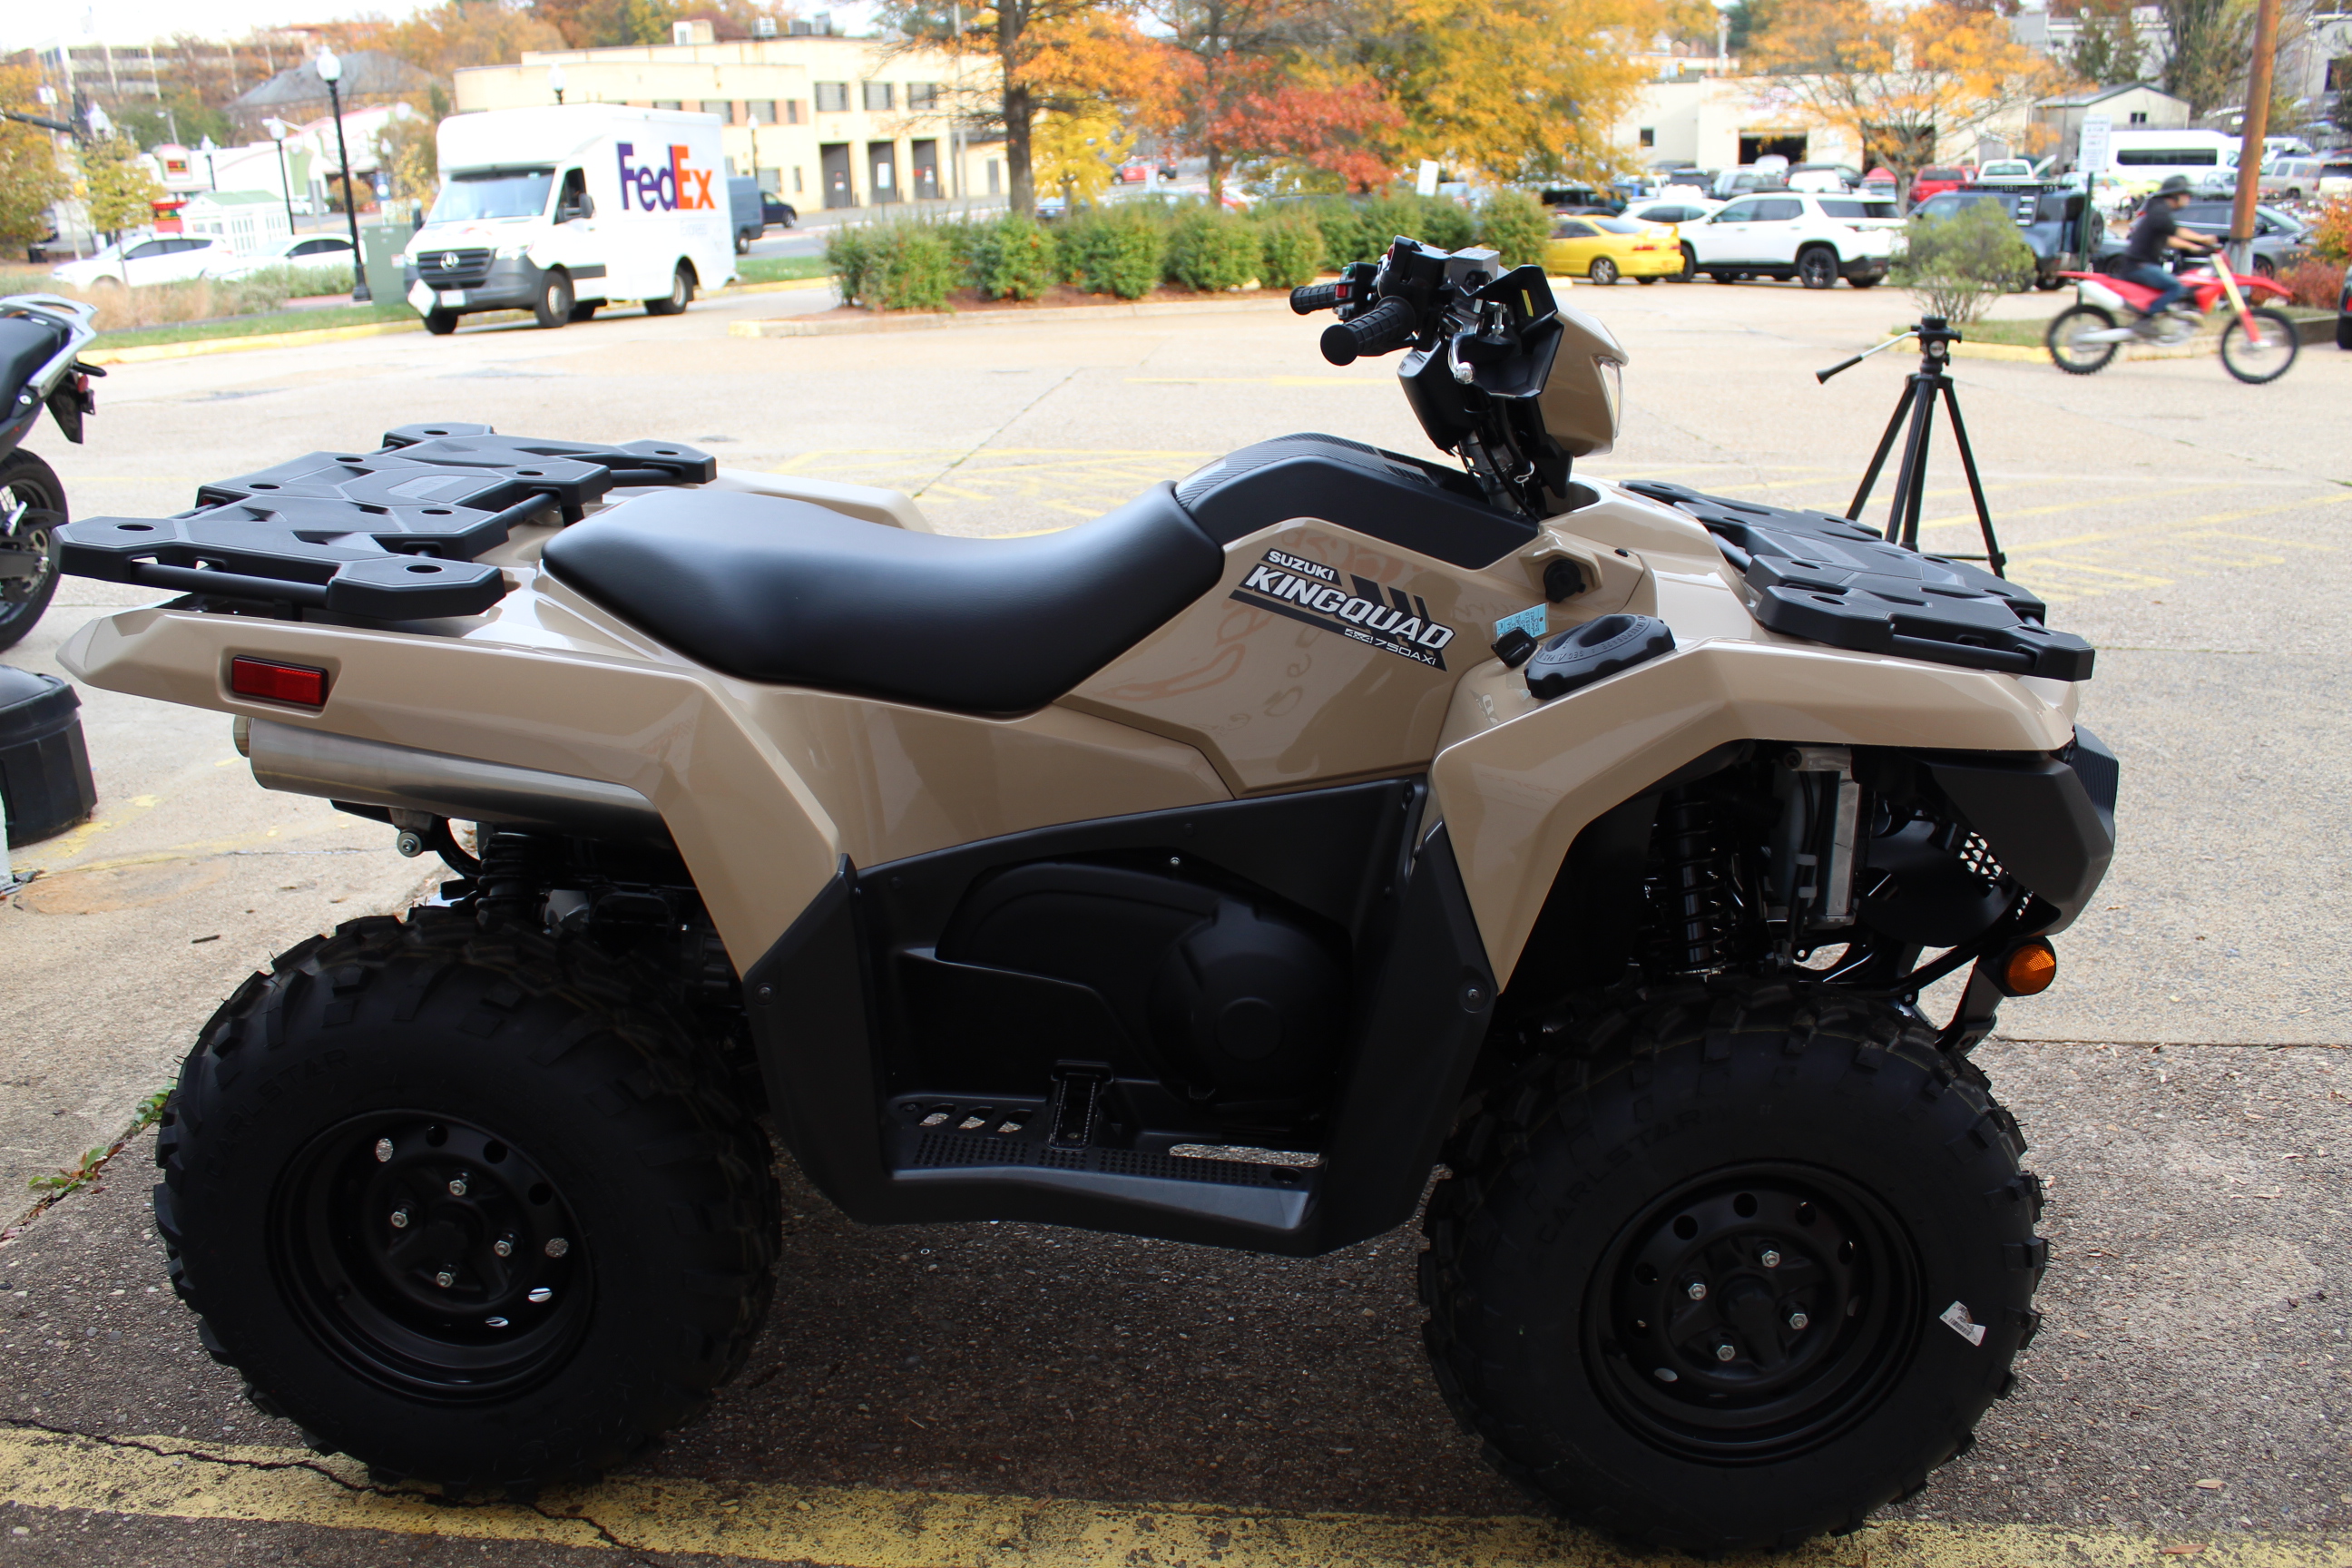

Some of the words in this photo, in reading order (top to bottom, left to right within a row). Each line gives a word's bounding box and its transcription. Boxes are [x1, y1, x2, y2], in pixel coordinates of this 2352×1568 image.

[617, 142, 716, 211] FedEx
[1269, 551, 1335, 581] SUZUKI
[1245, 565, 1455, 649] KINGQUAD
[1375, 640, 1436, 666] 750AXi
[1536, 1109, 1702, 1244] CARLSTAR
